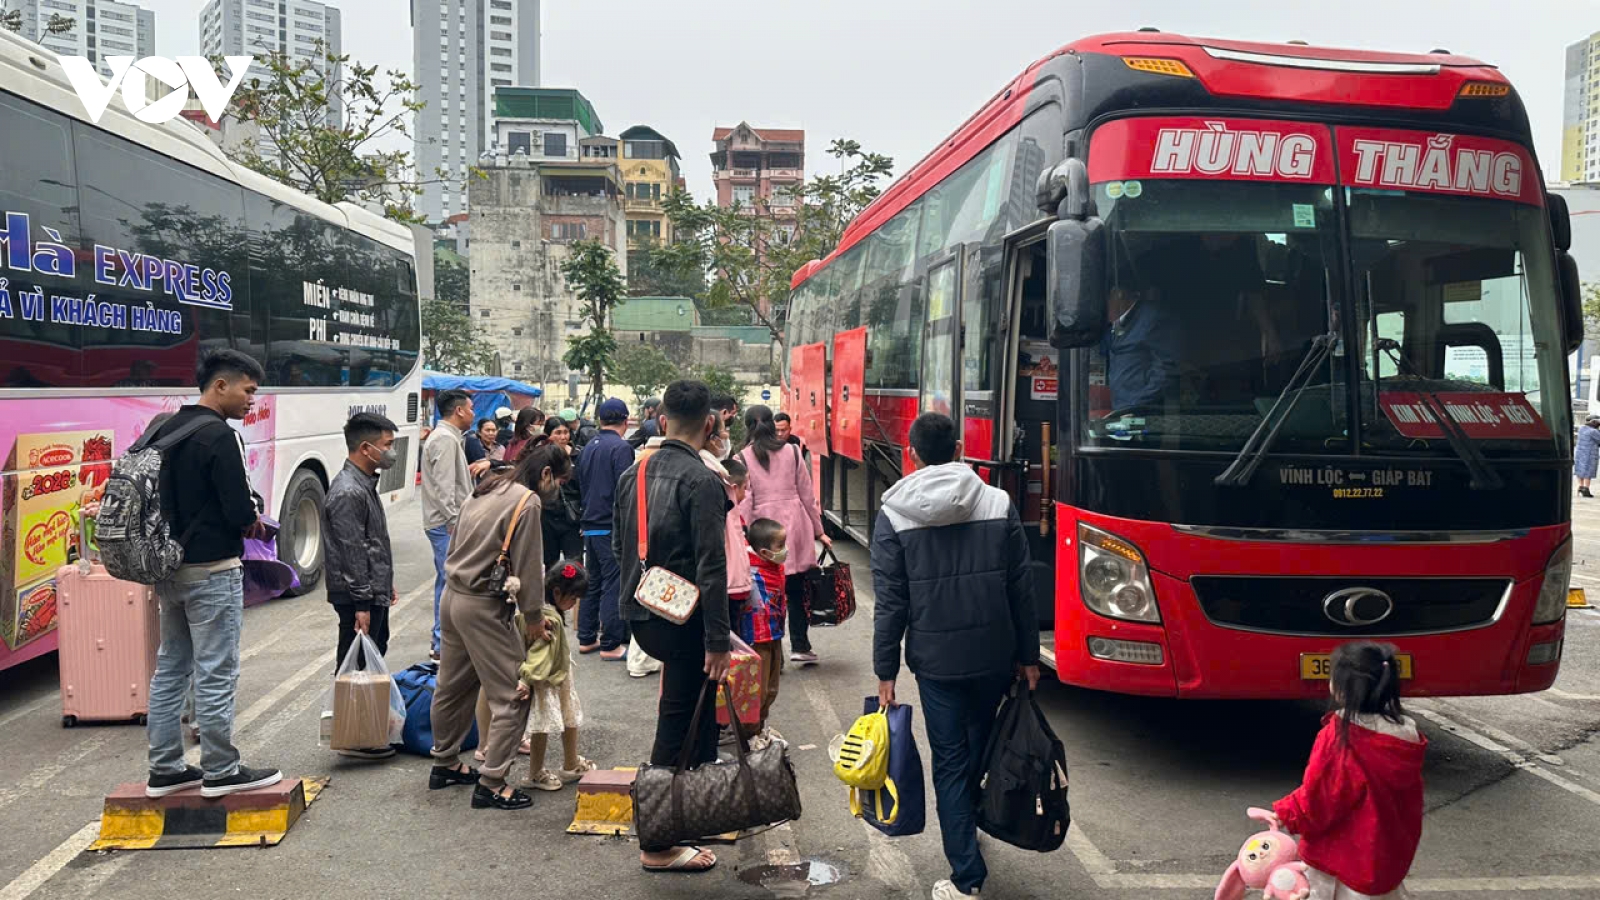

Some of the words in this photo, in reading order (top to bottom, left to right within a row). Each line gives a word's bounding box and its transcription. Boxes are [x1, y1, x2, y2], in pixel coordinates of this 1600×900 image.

[1150, 121, 1316, 178] HÙNG
[1352, 133, 1521, 197] THẮNG
[94, 244, 233, 310] EXPRESS
[19, 286, 44, 321] VÌ
[51, 294, 126, 330] KHÁCH
[131, 300, 182, 335] HÀNG
[33, 469, 71, 496] 2026
[1317, 464, 1344, 487] LỘC
